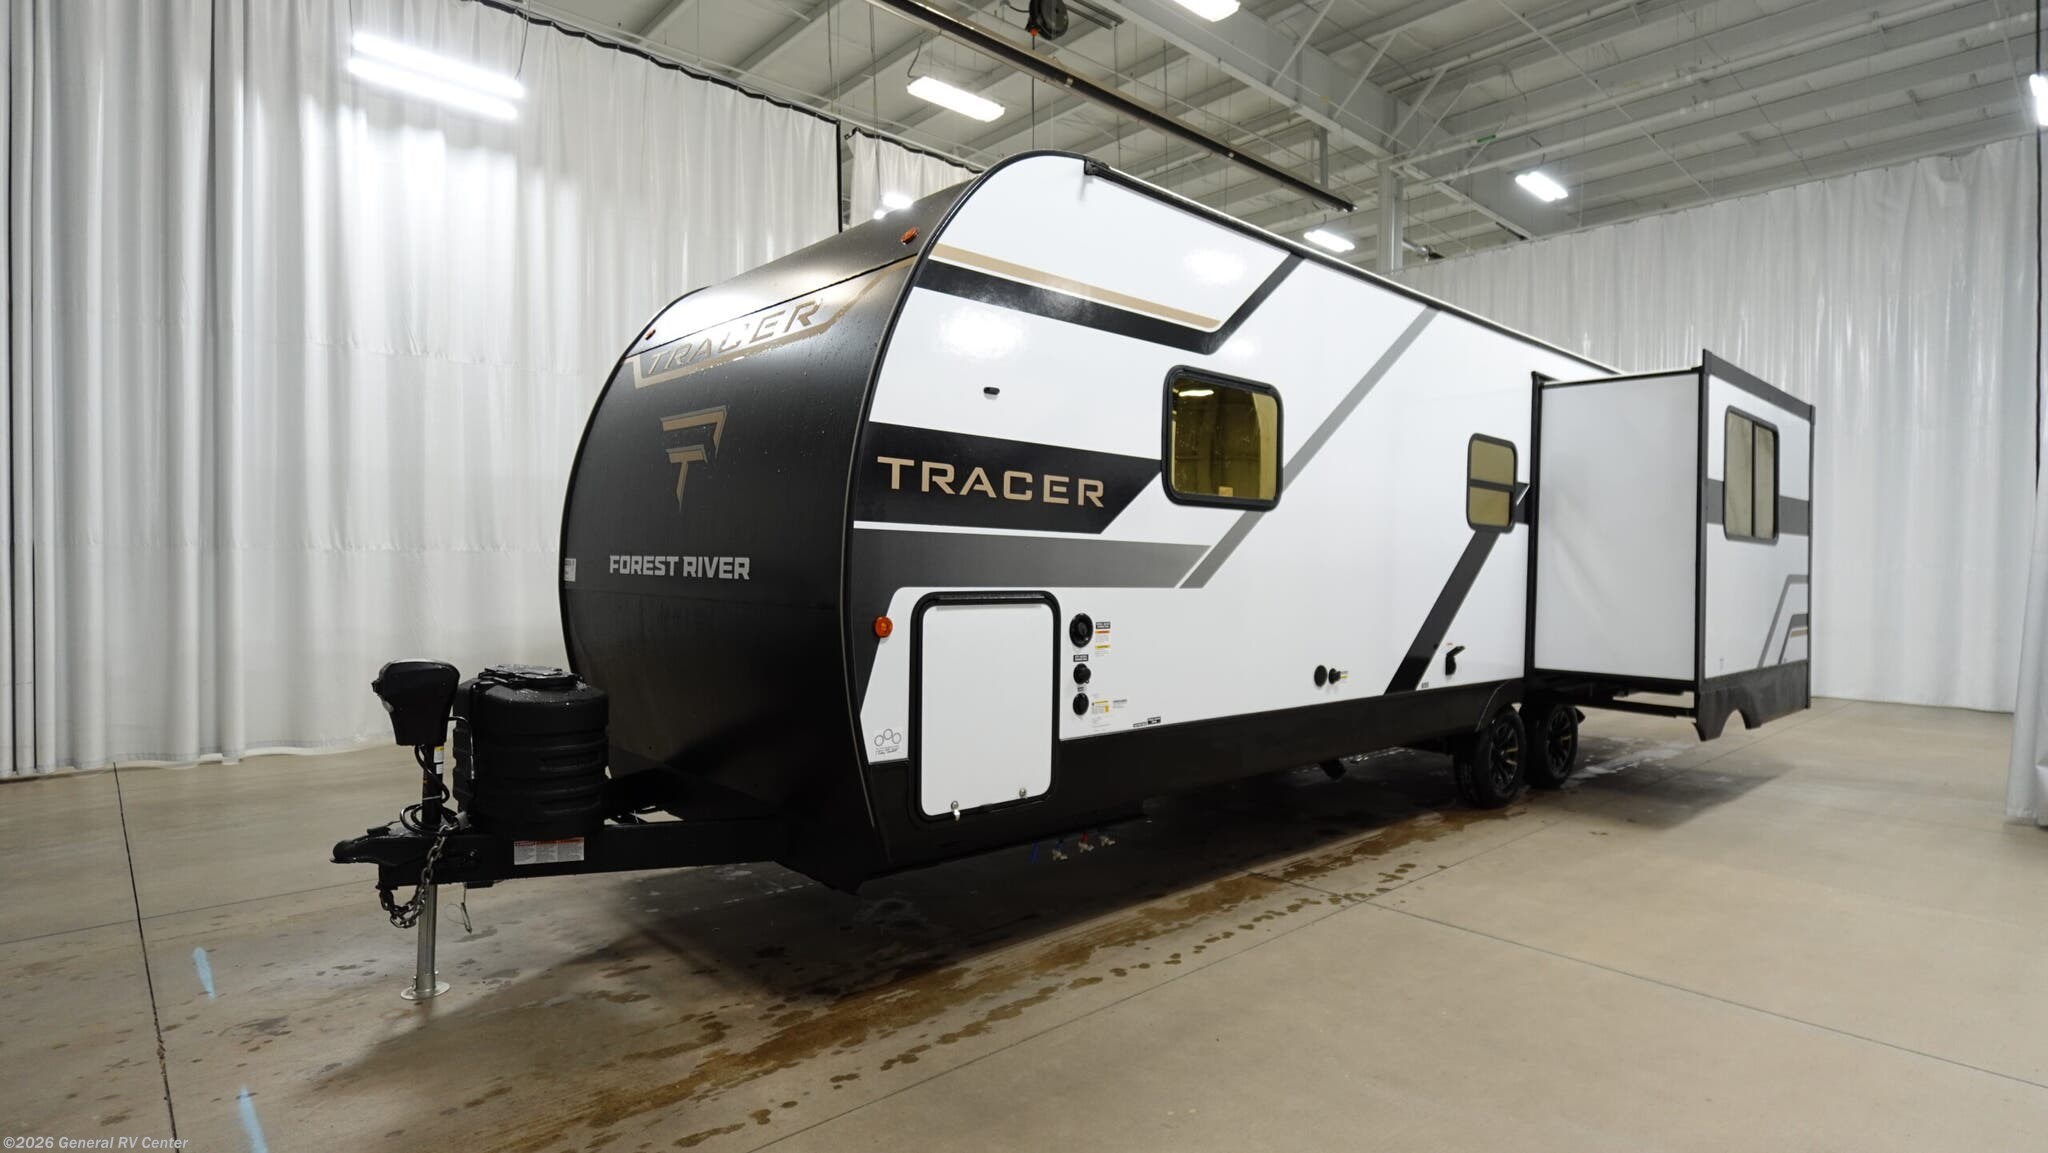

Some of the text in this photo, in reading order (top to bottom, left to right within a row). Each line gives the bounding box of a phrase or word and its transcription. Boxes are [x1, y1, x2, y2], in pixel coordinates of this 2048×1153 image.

[648, 299, 822, 375] TRACER
[877, 456, 1104, 508] TRACER
[609, 555, 750, 580] FOREST RIVER
